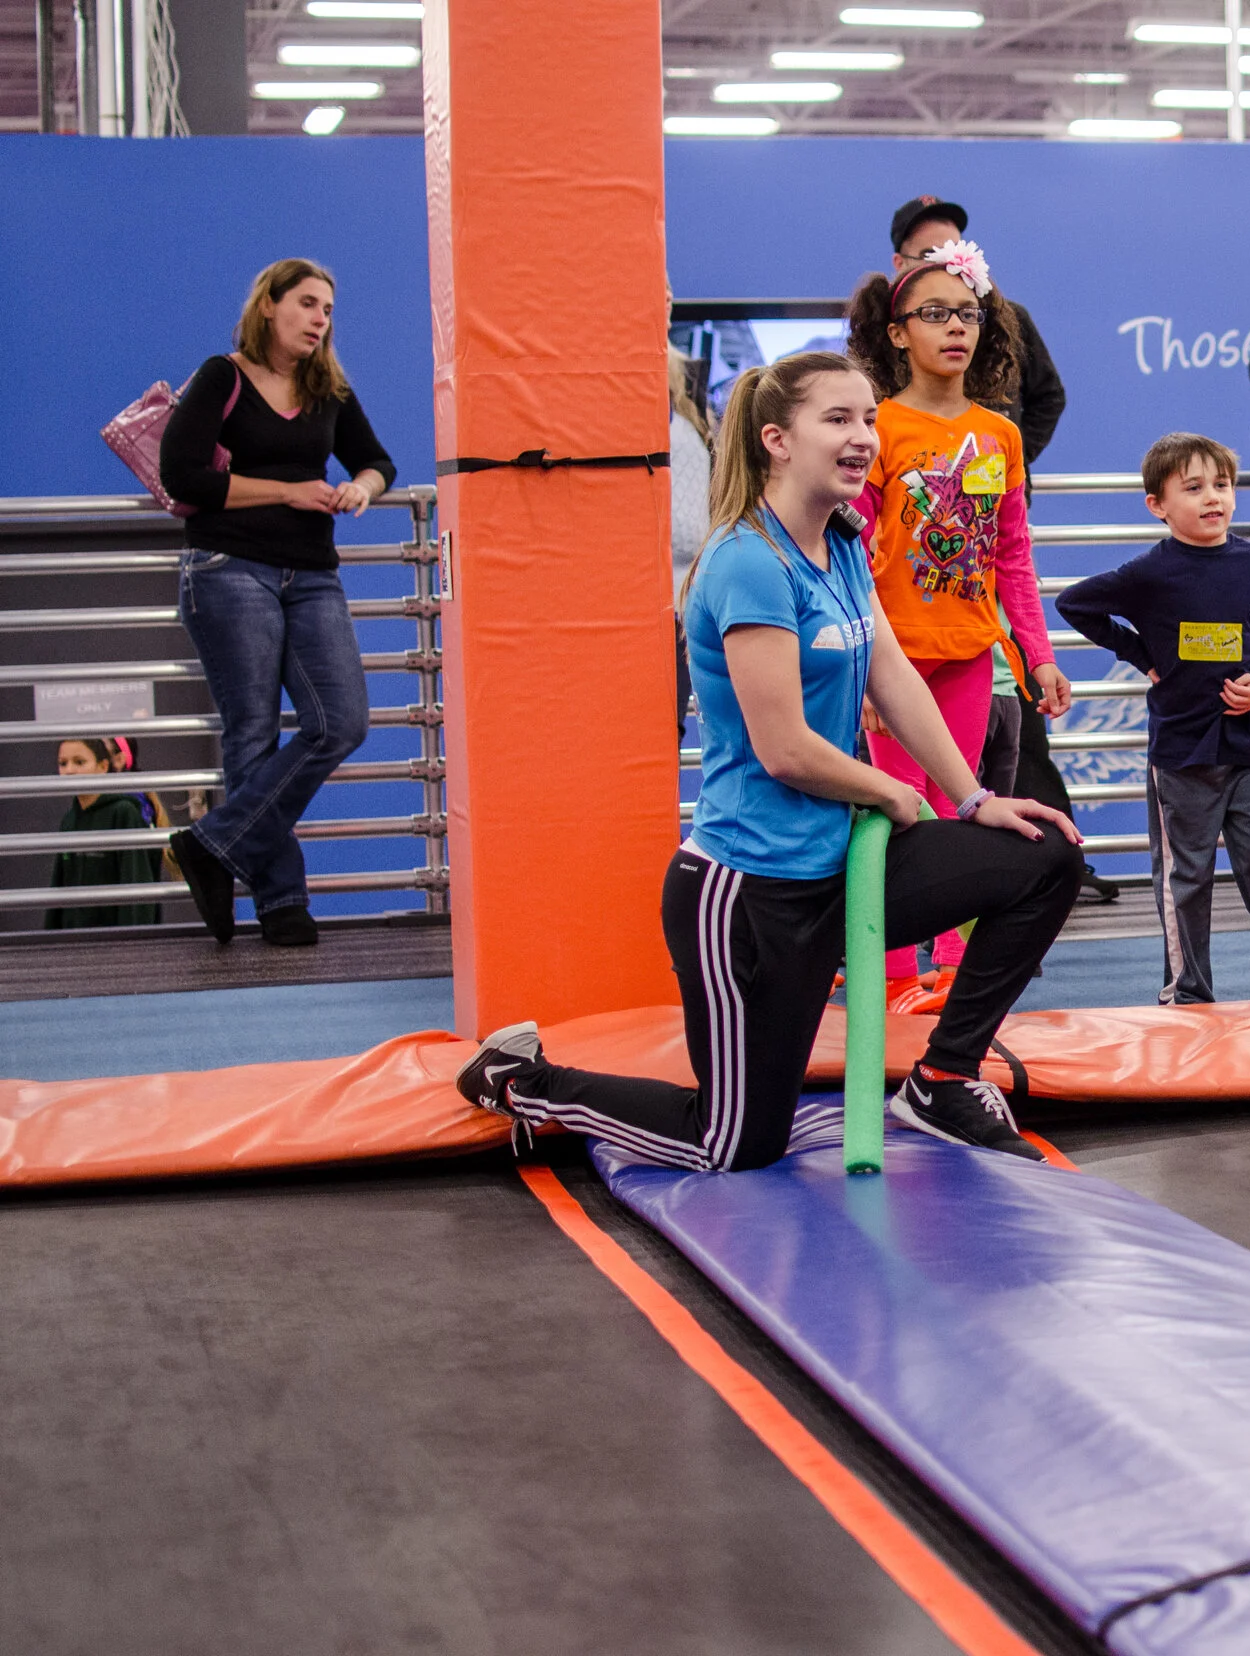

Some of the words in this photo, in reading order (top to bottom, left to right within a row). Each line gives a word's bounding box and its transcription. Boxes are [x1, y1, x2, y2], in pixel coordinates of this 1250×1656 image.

[40, 686, 77, 699] TEAM
[79, 682, 147, 695] MEMBERS
[77, 702, 112, 714] ONLY
